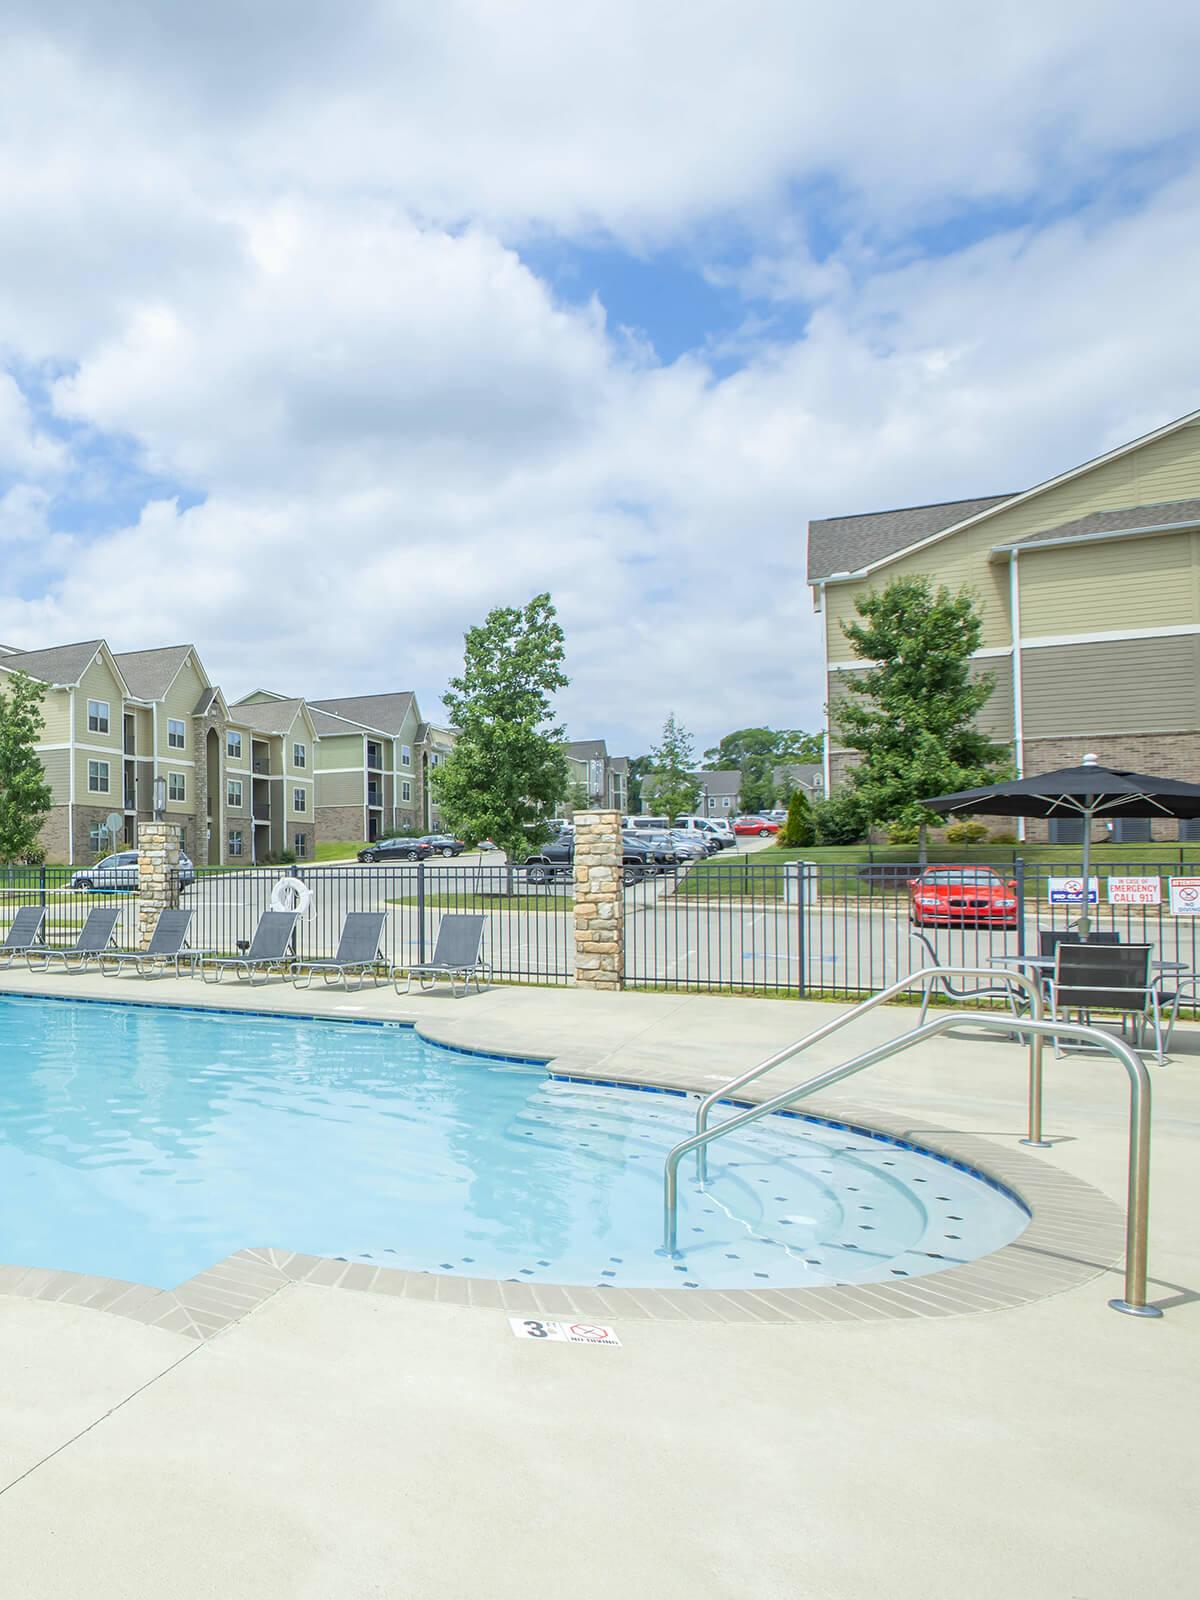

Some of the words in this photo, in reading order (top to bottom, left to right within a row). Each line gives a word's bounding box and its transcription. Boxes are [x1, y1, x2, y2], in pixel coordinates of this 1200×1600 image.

[1110, 884, 1157, 893] EMERGENCY
[1114, 893, 1136, 902] CALL
[1139, 893, 1154, 902] 911
[523, 1321, 548, 1338] 3
